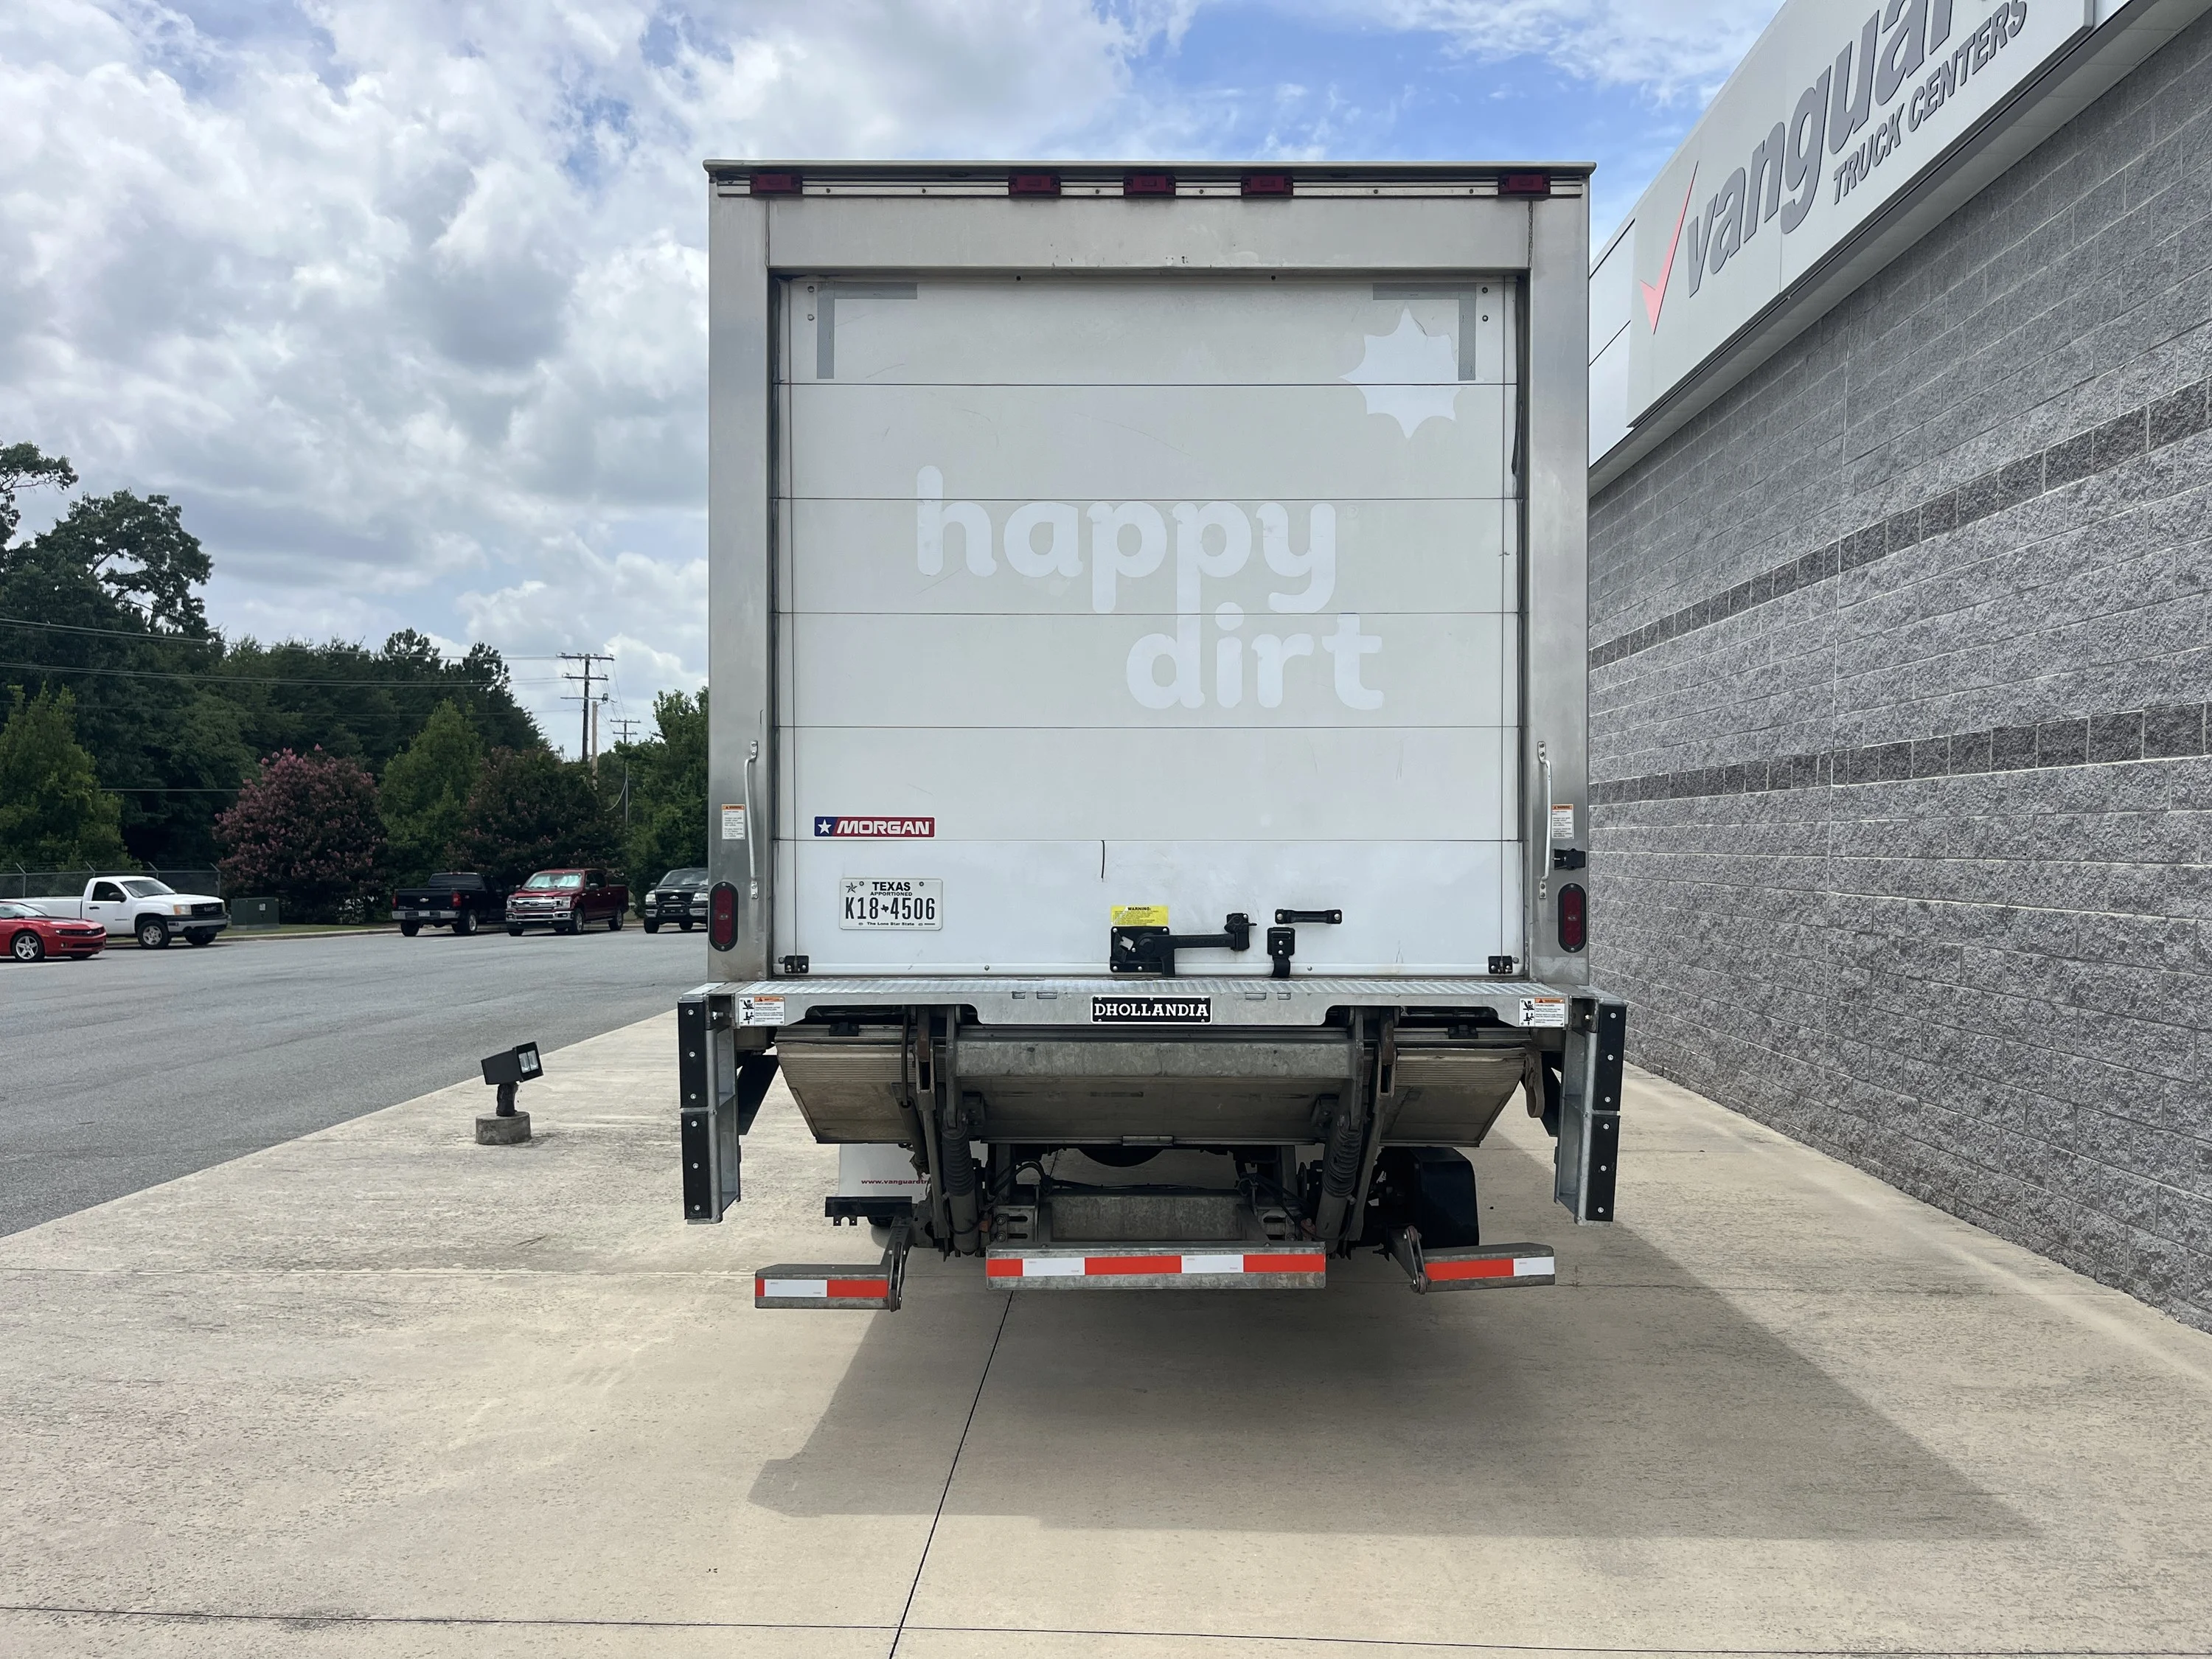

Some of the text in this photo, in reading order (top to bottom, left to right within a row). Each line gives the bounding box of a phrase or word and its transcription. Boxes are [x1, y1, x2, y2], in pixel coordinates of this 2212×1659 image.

[1834, 0, 2027, 205] TRUCK CENTERS
[917, 466, 1336, 613] happy
[1127, 602, 1385, 710] dirt
[837, 820, 929, 835] MORGAN
[872, 882, 911, 891] TEXAS
[1094, 1004, 1209, 1018] DHOLLANDIA
